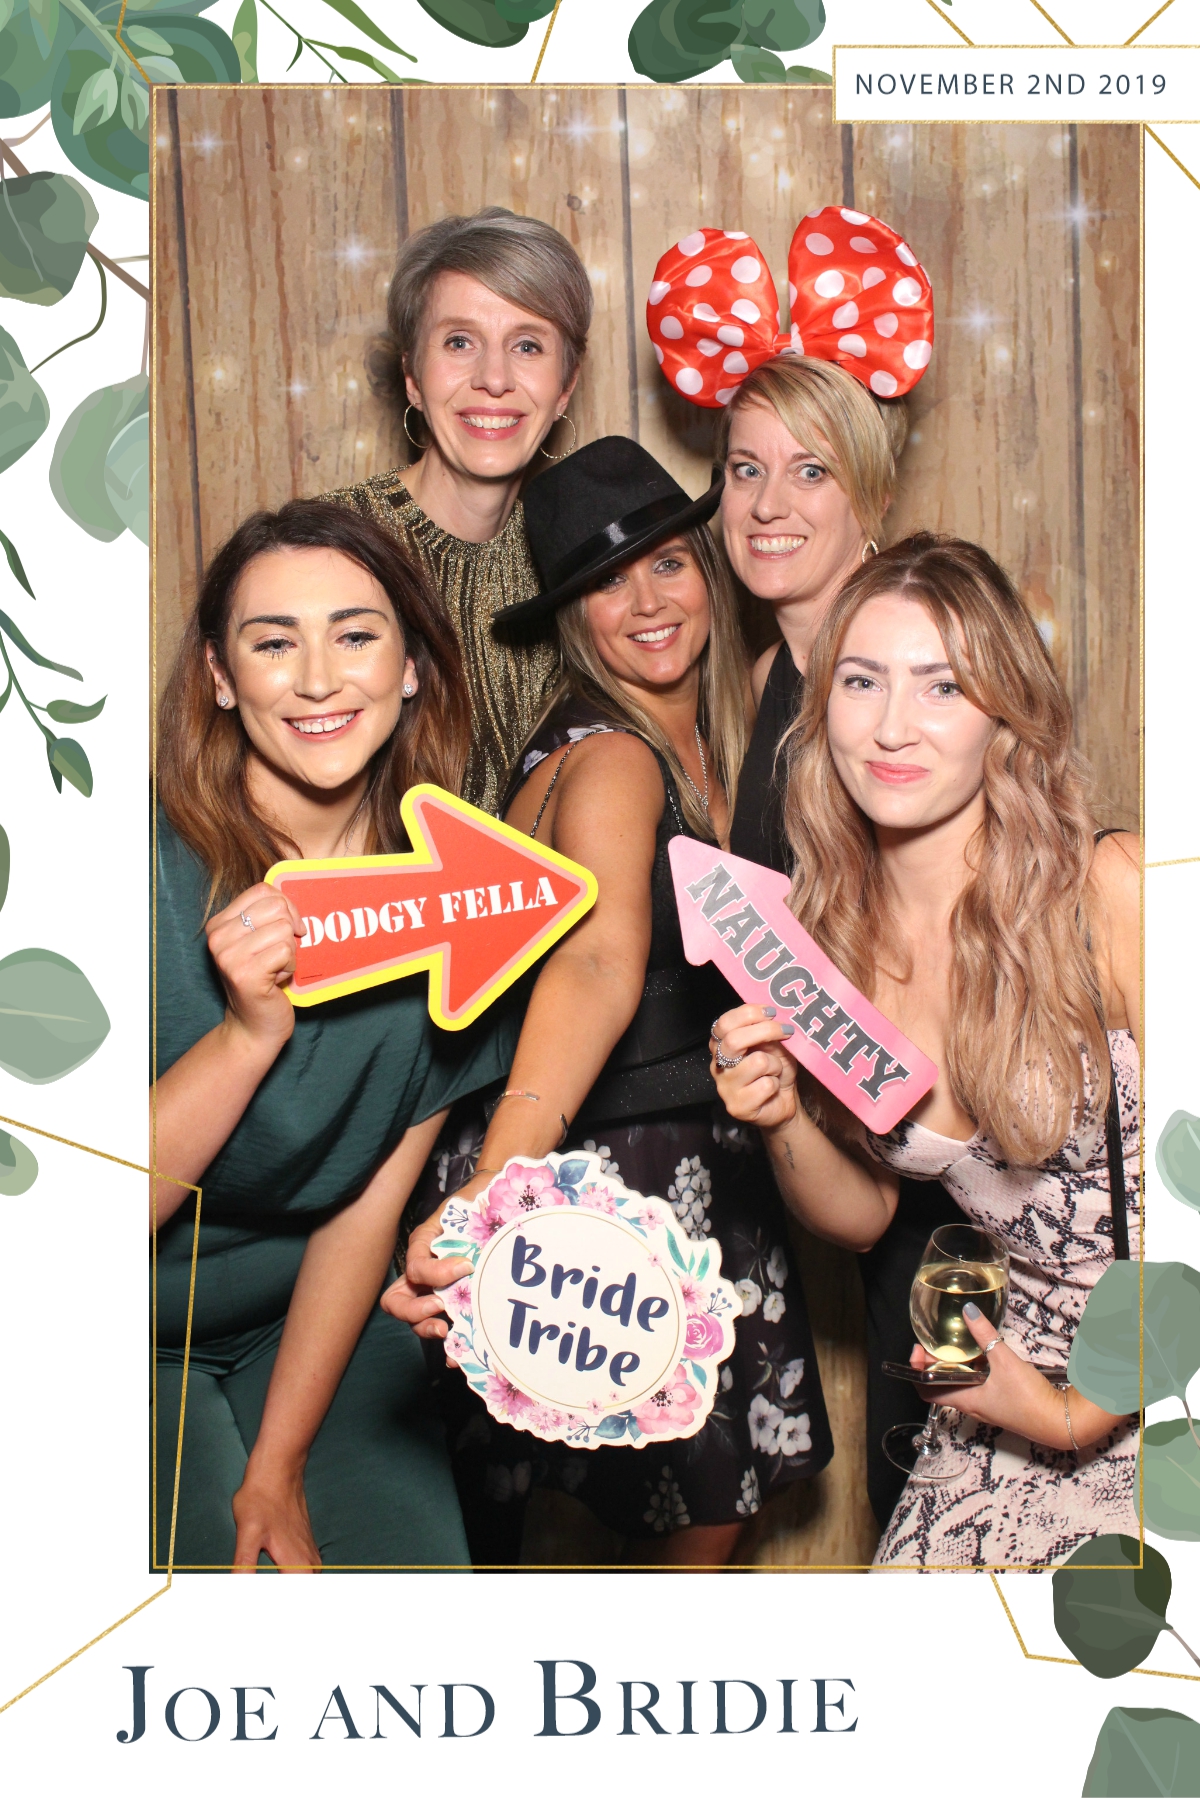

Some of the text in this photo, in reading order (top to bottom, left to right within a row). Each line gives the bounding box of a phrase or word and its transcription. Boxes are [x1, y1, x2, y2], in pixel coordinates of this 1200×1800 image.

[299, 876, 559, 948] DODGY FELLA
[684, 861, 913, 1103] NAUGHTY
[511, 1235, 670, 1333] Bride
[507, 1298, 641, 1387] Tribe
